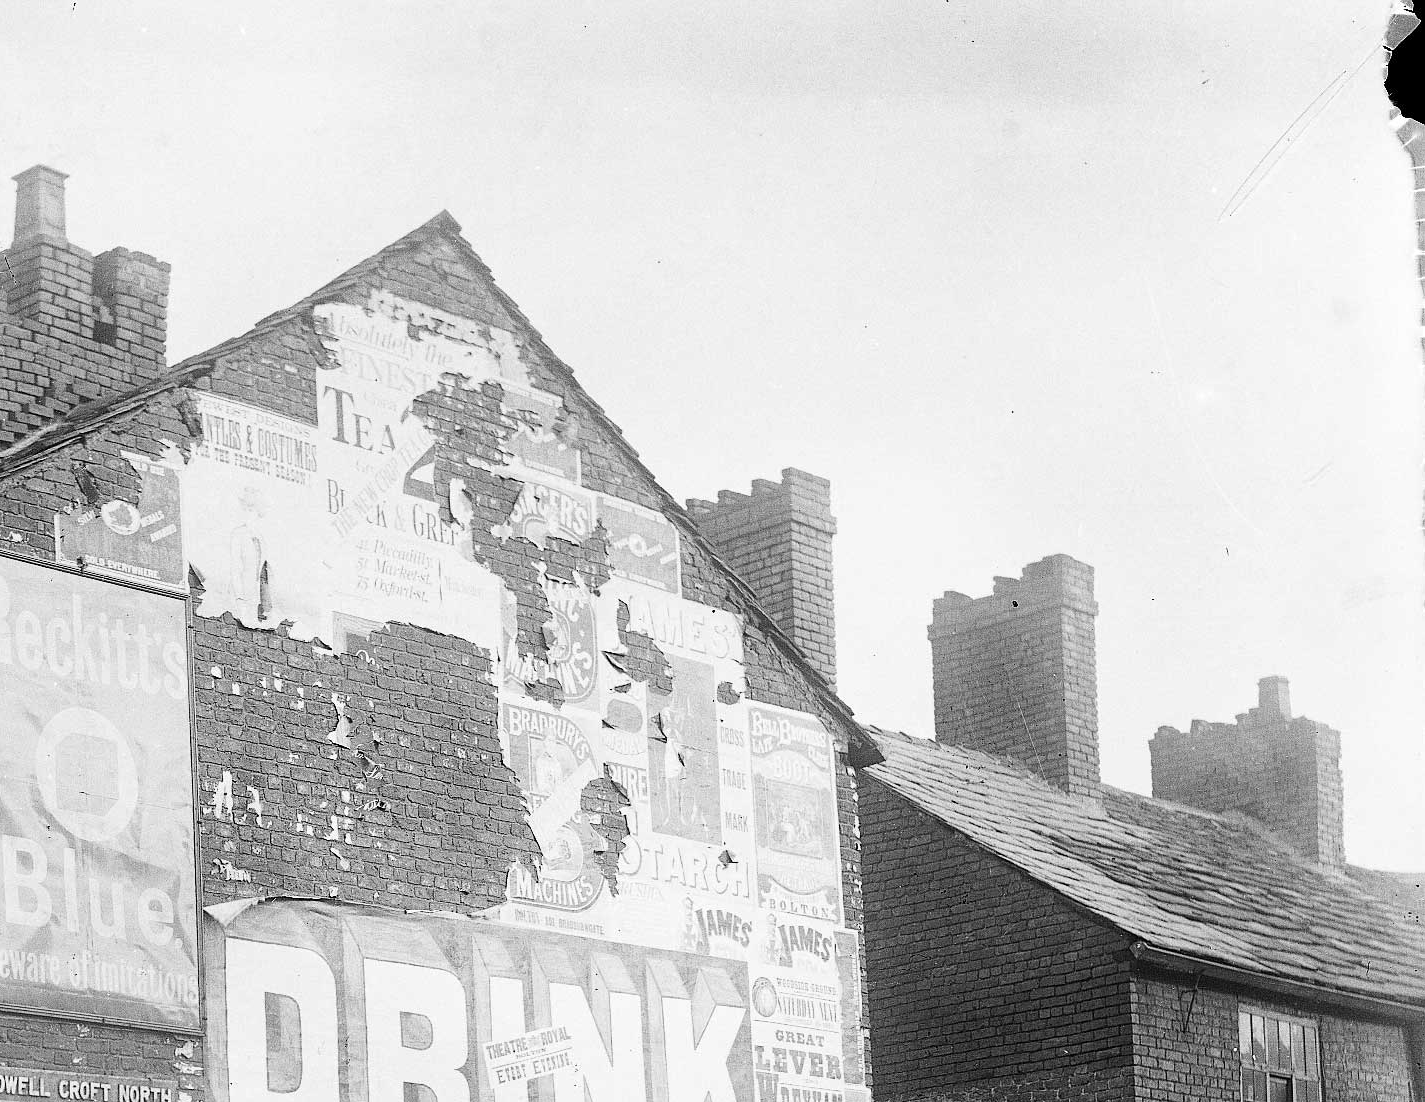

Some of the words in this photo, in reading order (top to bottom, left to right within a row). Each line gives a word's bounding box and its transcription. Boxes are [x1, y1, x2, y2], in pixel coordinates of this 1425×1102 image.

[323, 384, 396, 455] TEA
[246, 425, 253, 454] &
[258, 428, 317, 473] COSTUMES
[84, 554, 105, 568] SOLD
[508, 708, 591, 760] BRADBURY'S
[722, 768, 747, 791] TRADE
[725, 811, 749, 833] MARK
[513, 868, 594, 907] MACHINES
[769, 898, 830, 920] BOLTON
[696, 908, 752, 956] JAMES'
[777, 922, 833, 968] JAMES'
[71, 950, 94, 990] of
[94, 957, 198, 1002] imitations
[486, 1038, 528, 1060] THEATRE
[540, 1026, 571, 1046] ROYAL
[775, 1030, 825, 1047] GREAT
[496, 1064, 527, 1084] EVERY
[754, 1045, 842, 1080] LEVER
[58, 1080, 112, 1102] CROFT
